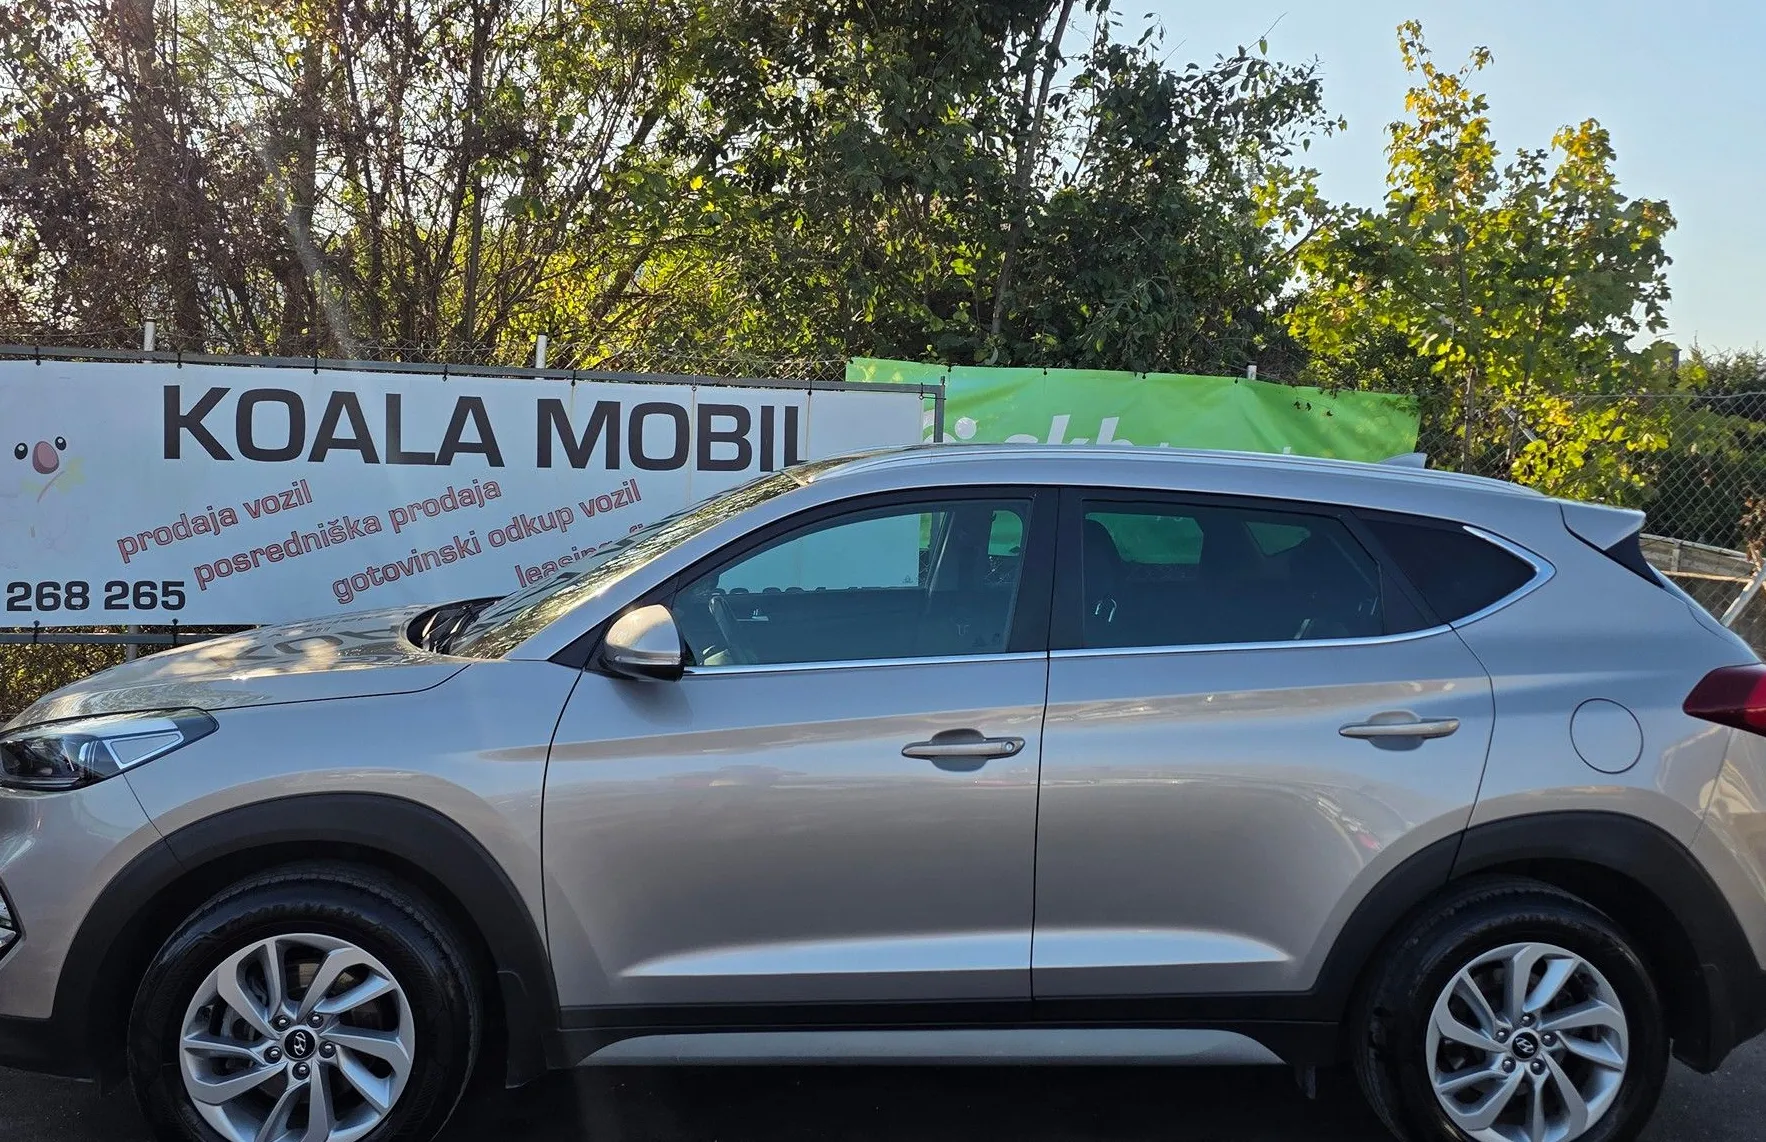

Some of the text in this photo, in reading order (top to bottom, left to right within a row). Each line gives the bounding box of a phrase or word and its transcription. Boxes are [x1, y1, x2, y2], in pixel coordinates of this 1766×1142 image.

[163, 384, 813, 474] KOALA MOBIL
[117, 478, 313, 564] prodaja vozil
[193, 478, 502, 592] posredniška prodaja
[332, 478, 642, 605] gotovinski odkup vozil
[6, 580, 186, 612] 268 265
